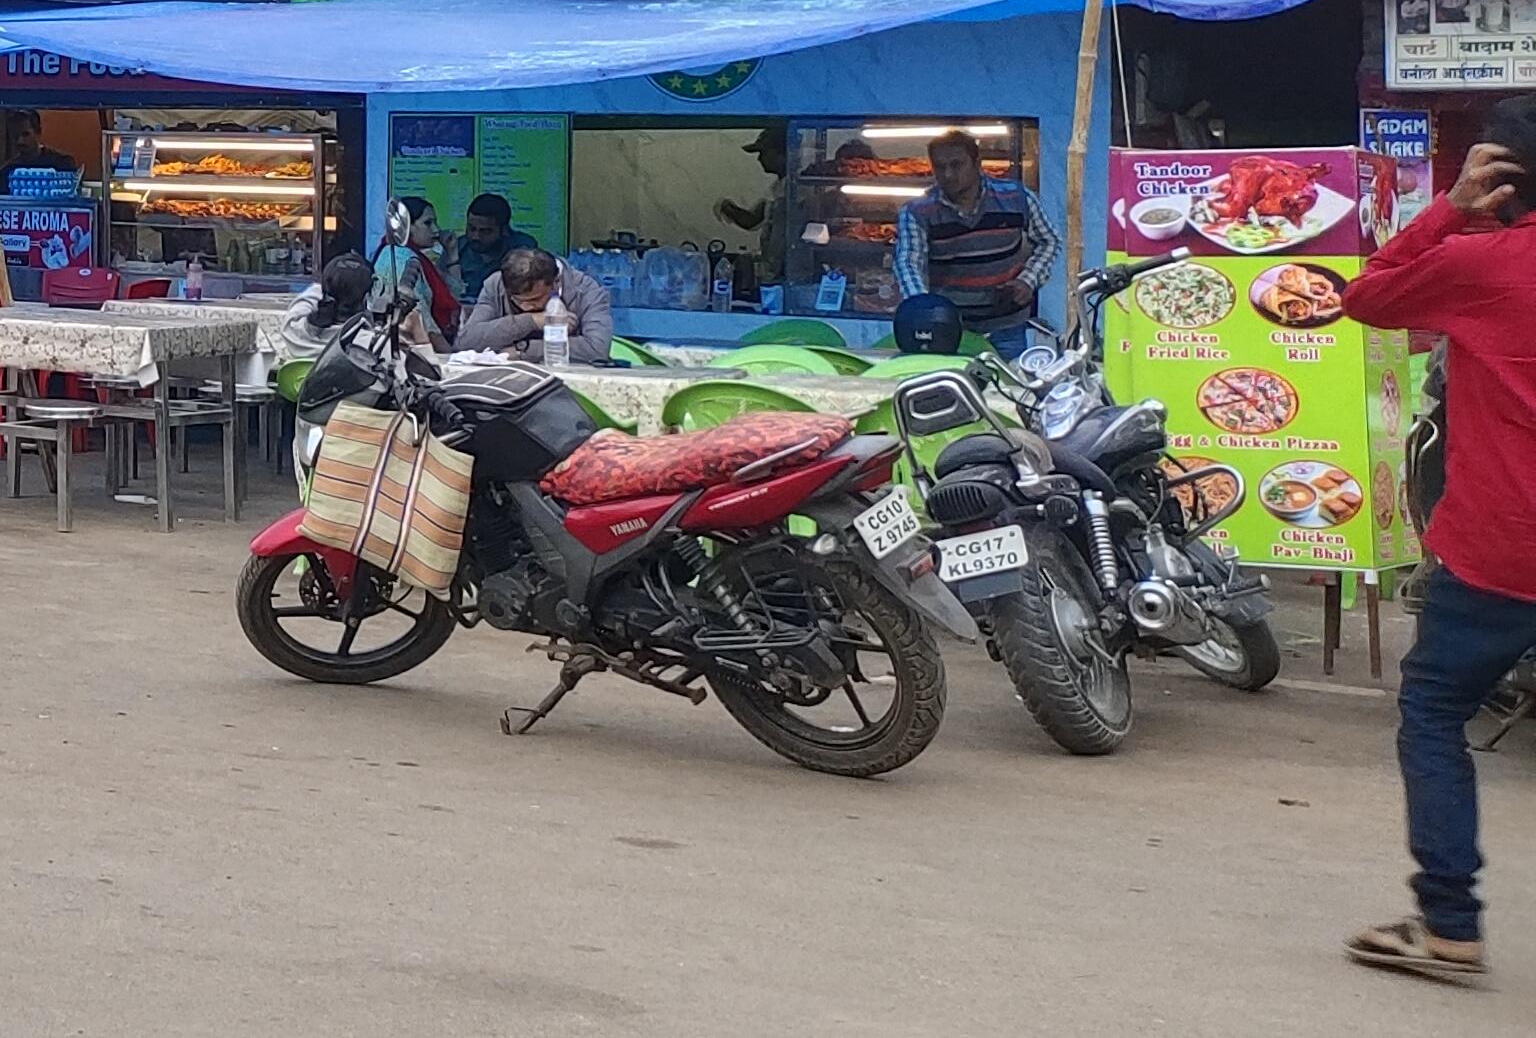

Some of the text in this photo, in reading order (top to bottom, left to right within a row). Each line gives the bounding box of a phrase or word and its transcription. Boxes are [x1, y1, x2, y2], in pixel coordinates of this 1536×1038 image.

[1135, 163, 1210, 177] Tandoor
[1138, 181, 1210, 195] Chicken
[22, 211, 69, 232] AROMA
[1157, 331, 1218, 344] Chicken
[1270, 332, 1334, 344] Chicken
[1148, 346, 1228, 359] Fried Rice
[1288, 348, 1319, 360] Roll
[1218, 436, 1280, 449] Chicken
[868, 500, 904, 530] CG10
[609, 517, 648, 537] YAMAHA
[874, 515, 917, 552] Z 9745
[1281, 530, 1344, 544] Chicken
[955, 537, 1005, 558] CG17
[949, 552, 1018, 577] KL9370
